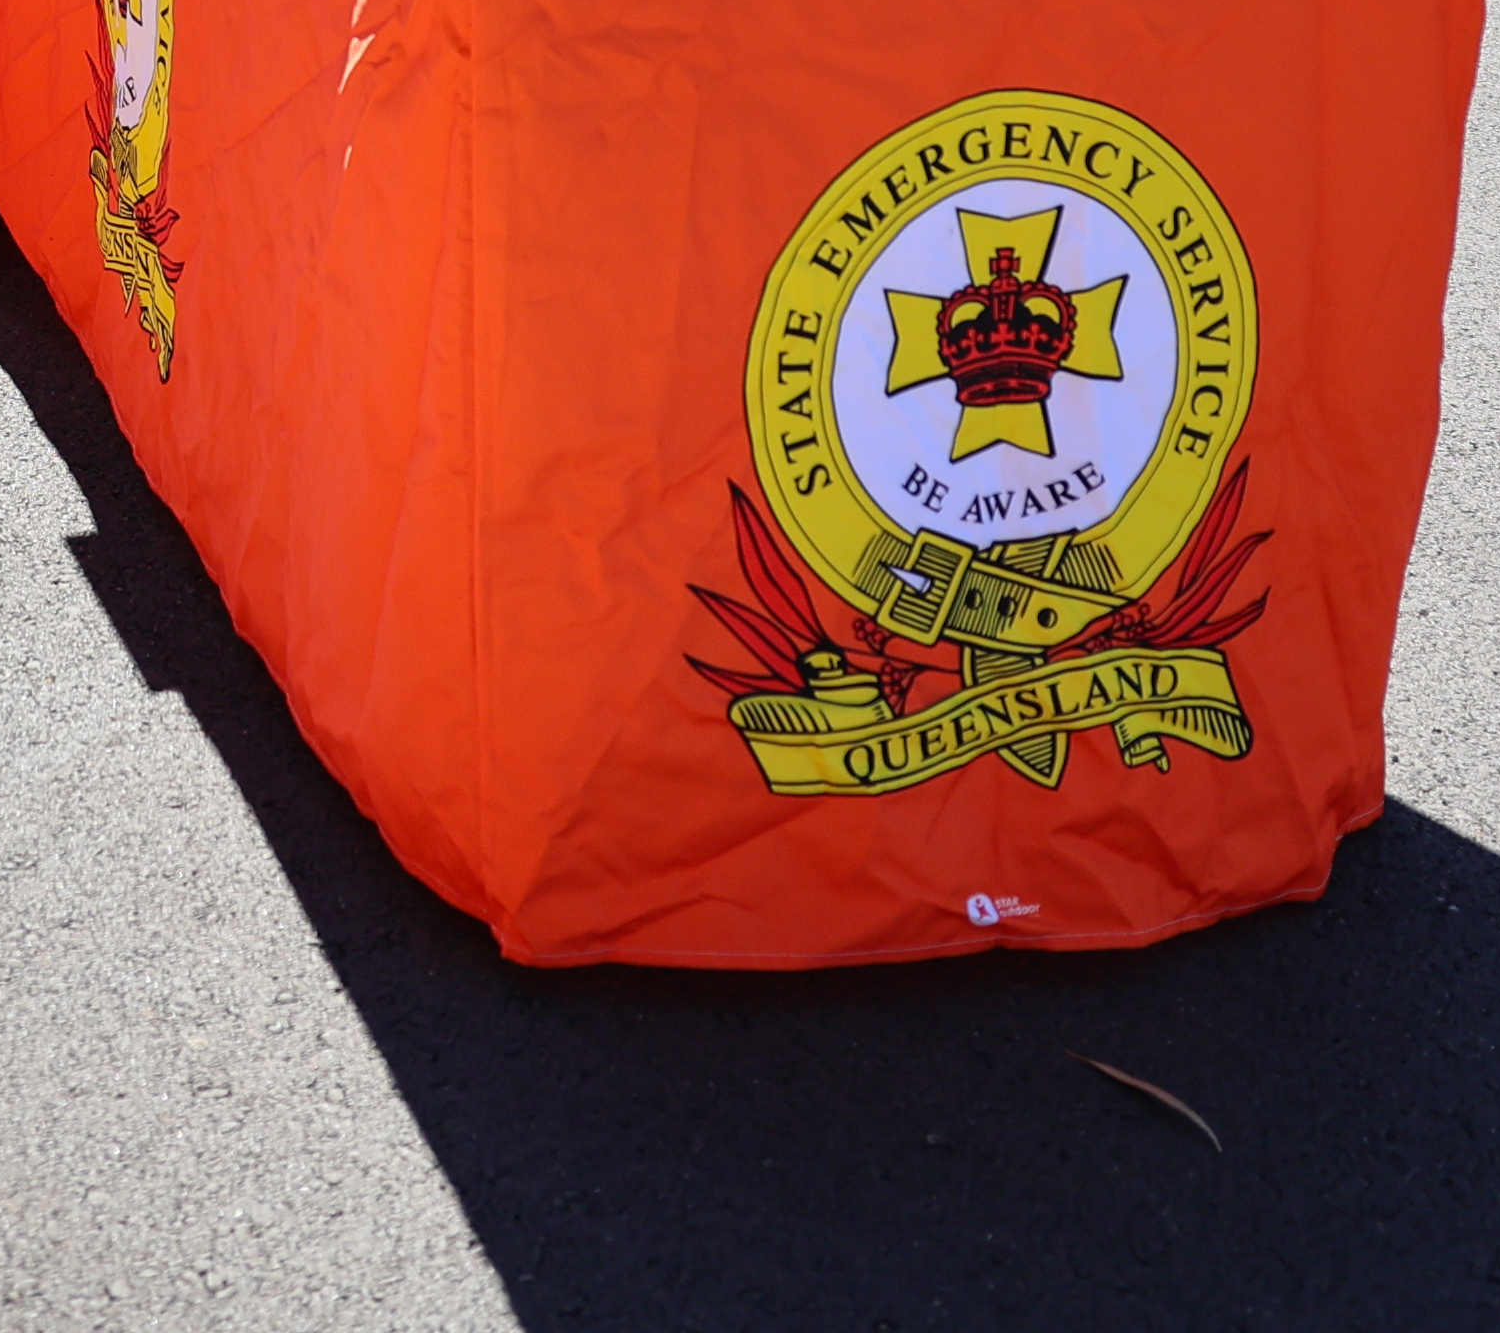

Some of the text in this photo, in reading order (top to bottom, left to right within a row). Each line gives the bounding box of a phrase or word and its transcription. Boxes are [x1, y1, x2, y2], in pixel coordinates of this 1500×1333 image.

[779, 122, 1230, 496] STATE EMERGENCY SERVICE
[901, 461, 1106, 526] BE AWARE
[843, 662, 1180, 781] QUEENSLAND
